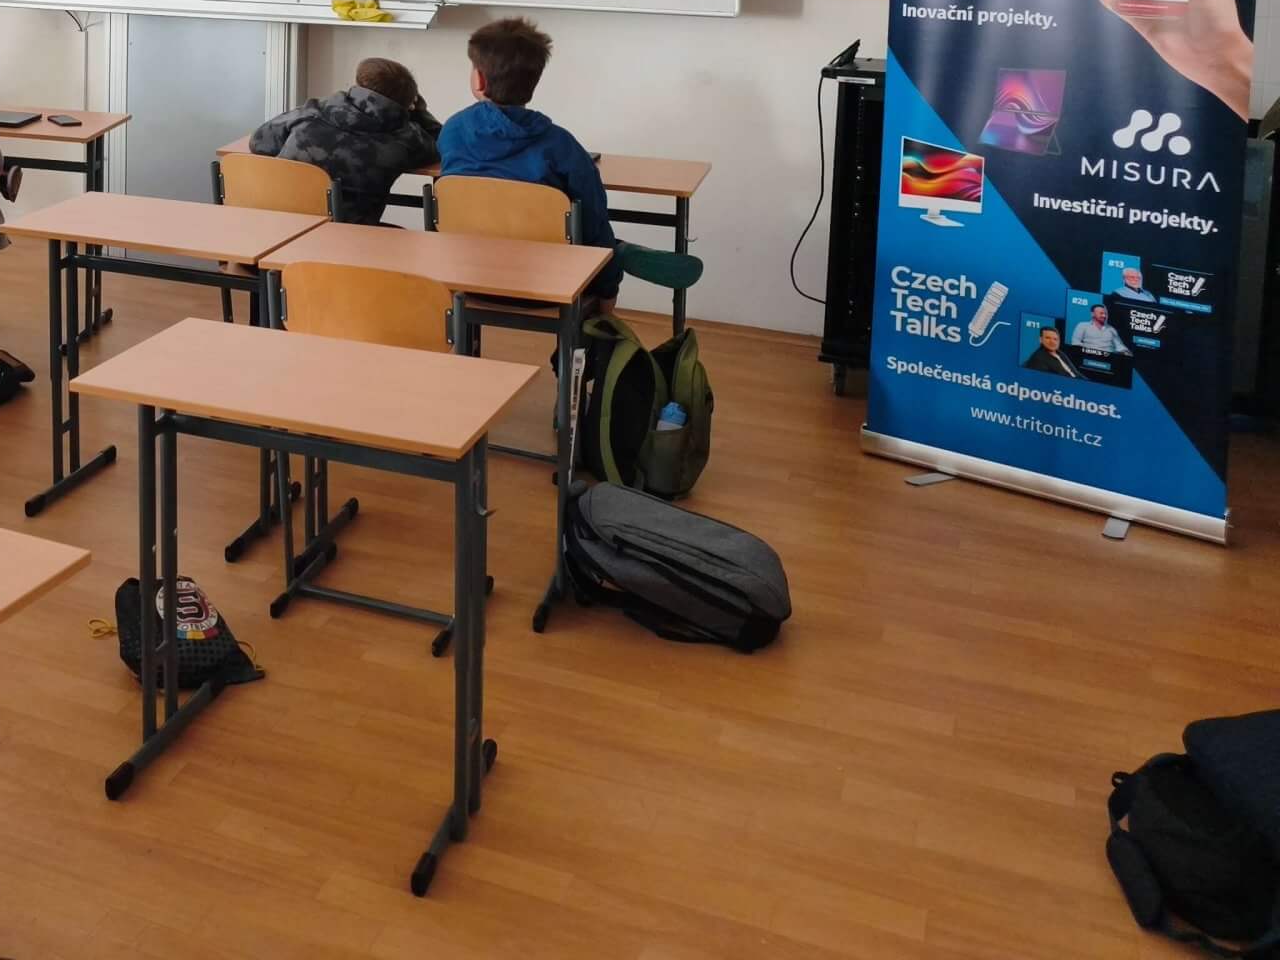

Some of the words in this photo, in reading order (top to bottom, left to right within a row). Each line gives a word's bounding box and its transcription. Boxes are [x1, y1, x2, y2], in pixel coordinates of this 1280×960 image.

[902, 3, 974, 22] Inovační
[977, 8, 1058, 29] projekty.
[1081, 156, 1221, 193] MISURA
[1033, 193, 1125, 220] Investiční
[1129, 205, 1219, 234] projekty.
[890, 265, 977, 300] Czech
[1167, 272, 1196, 284] Czech
[1167, 279, 1190, 289] Tech
[1167, 285, 1191, 296] Talks
[890, 288, 958, 319] Tech
[1130, 310, 1157, 321] Czech
[890, 311, 962, 344] Talks
[1129, 322, 1152, 333] Talks
[1130, 316, 1151, 326] Tech
[887, 356, 992, 391] Společenská
[996, 379, 1122, 420] odpovědnost.
[970, 406, 1103, 447] www.tritonit.cz
